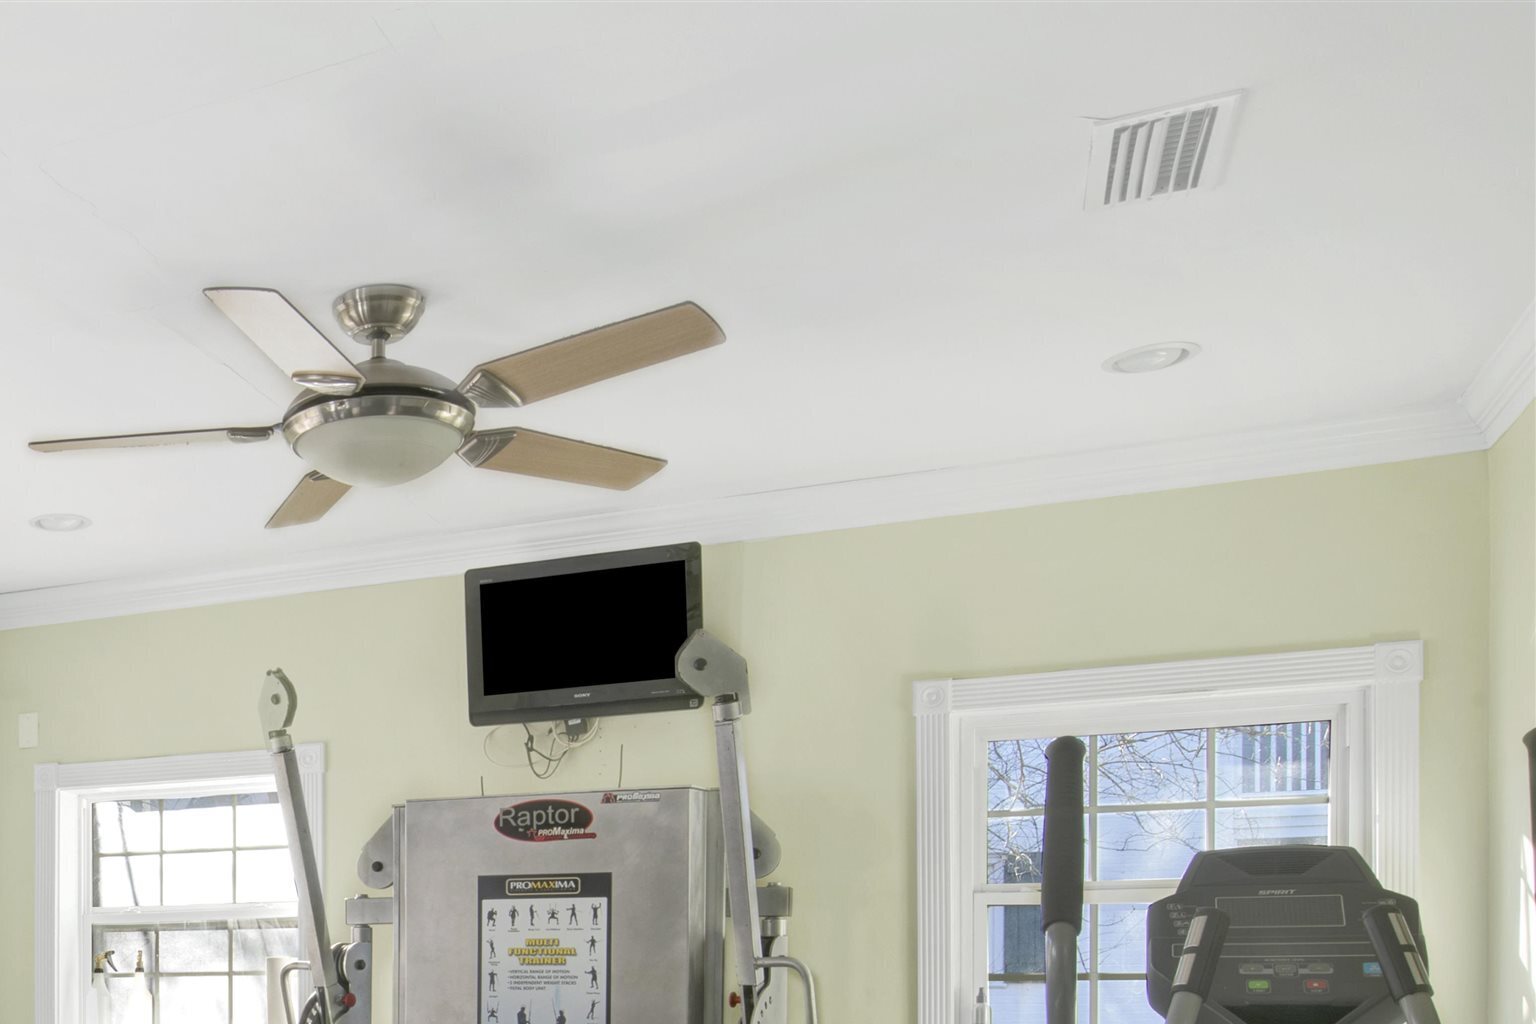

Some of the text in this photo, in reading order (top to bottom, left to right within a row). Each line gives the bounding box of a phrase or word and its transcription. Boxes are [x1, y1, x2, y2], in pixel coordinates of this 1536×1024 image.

[499, 804, 580, 829] Raptor
[510, 880, 576, 890] PROMAXIMA
[525, 938, 560, 947] MULTI
[508, 947, 577, 956] FUNCTIONAL
[519, 957, 567, 965] TRAINER
